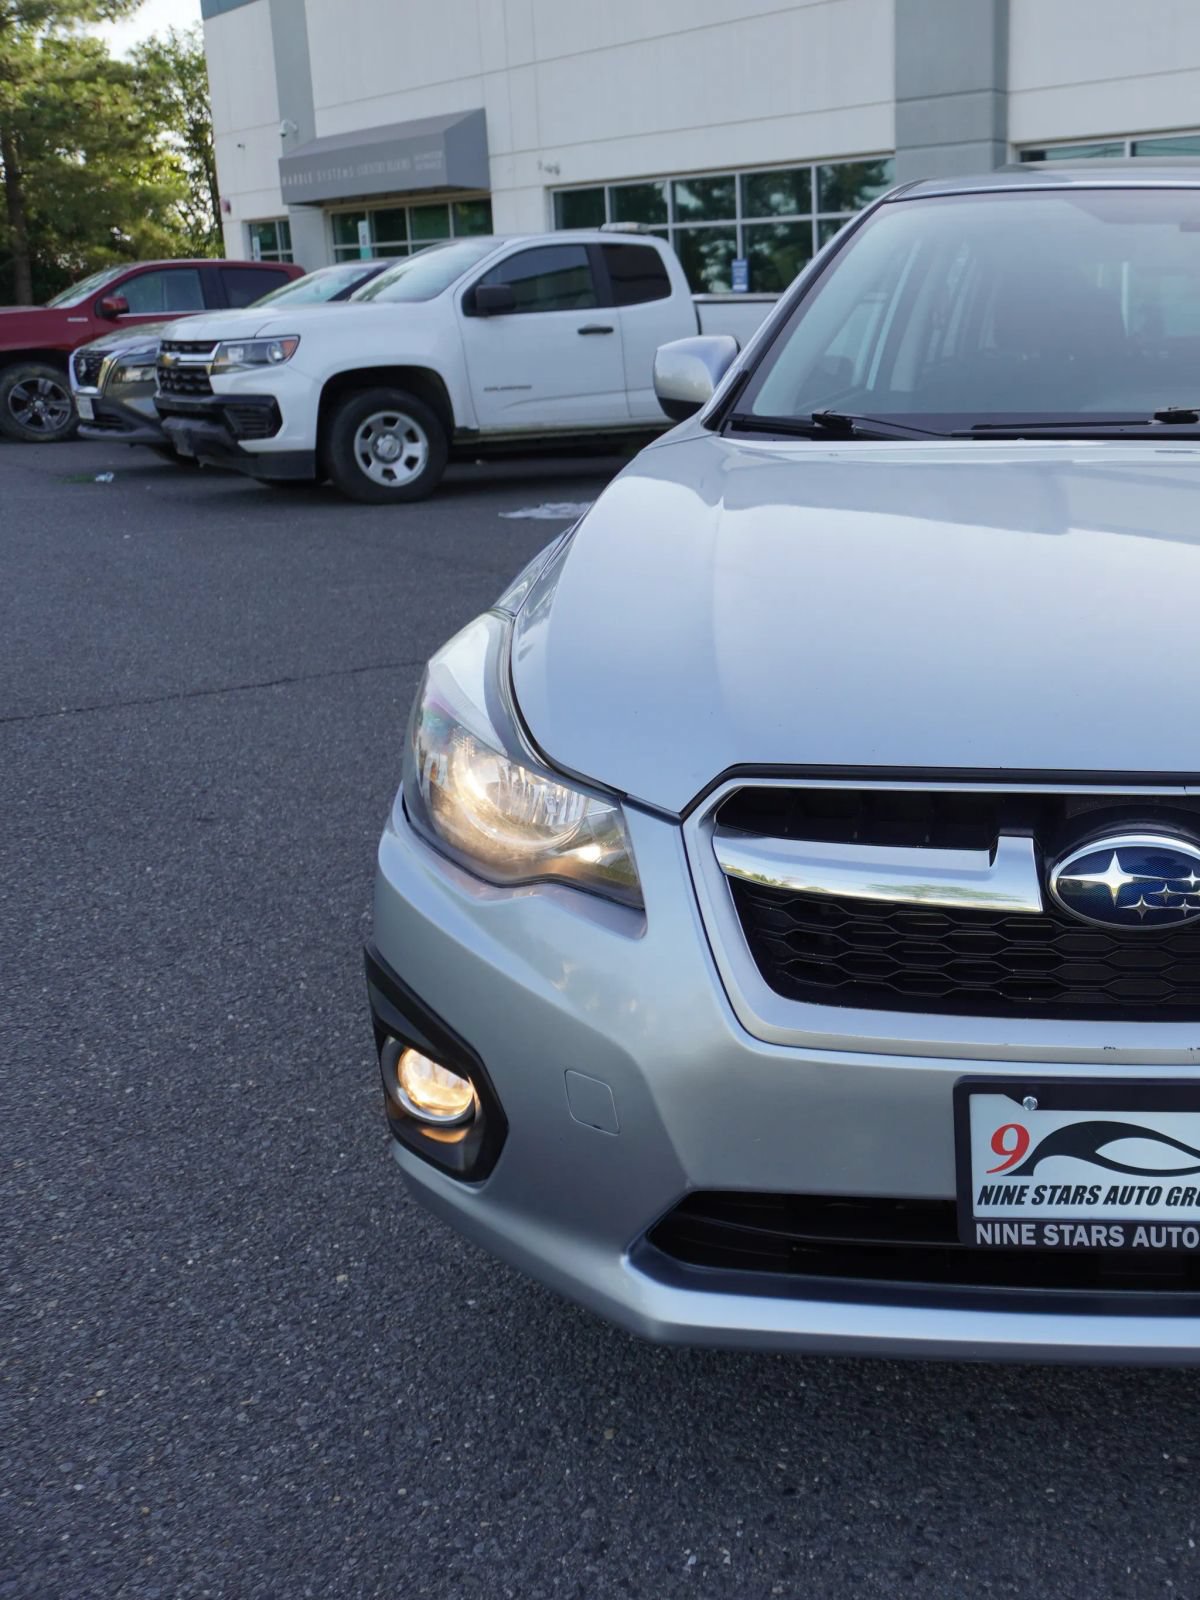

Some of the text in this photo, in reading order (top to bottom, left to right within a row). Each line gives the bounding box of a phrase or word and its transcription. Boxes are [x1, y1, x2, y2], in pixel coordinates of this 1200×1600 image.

[986, 1123, 1030, 1174] 9
[977, 1185, 1029, 1206] NINE
[1031, 1185, 1101, 1206] STARS
[1104, 1186, 1164, 1207] AUTO
[975, 1224, 1036, 1246] NINE
[1043, 1225, 1125, 1247] STARS
[1132, 1227, 1200, 1248] AUTO
